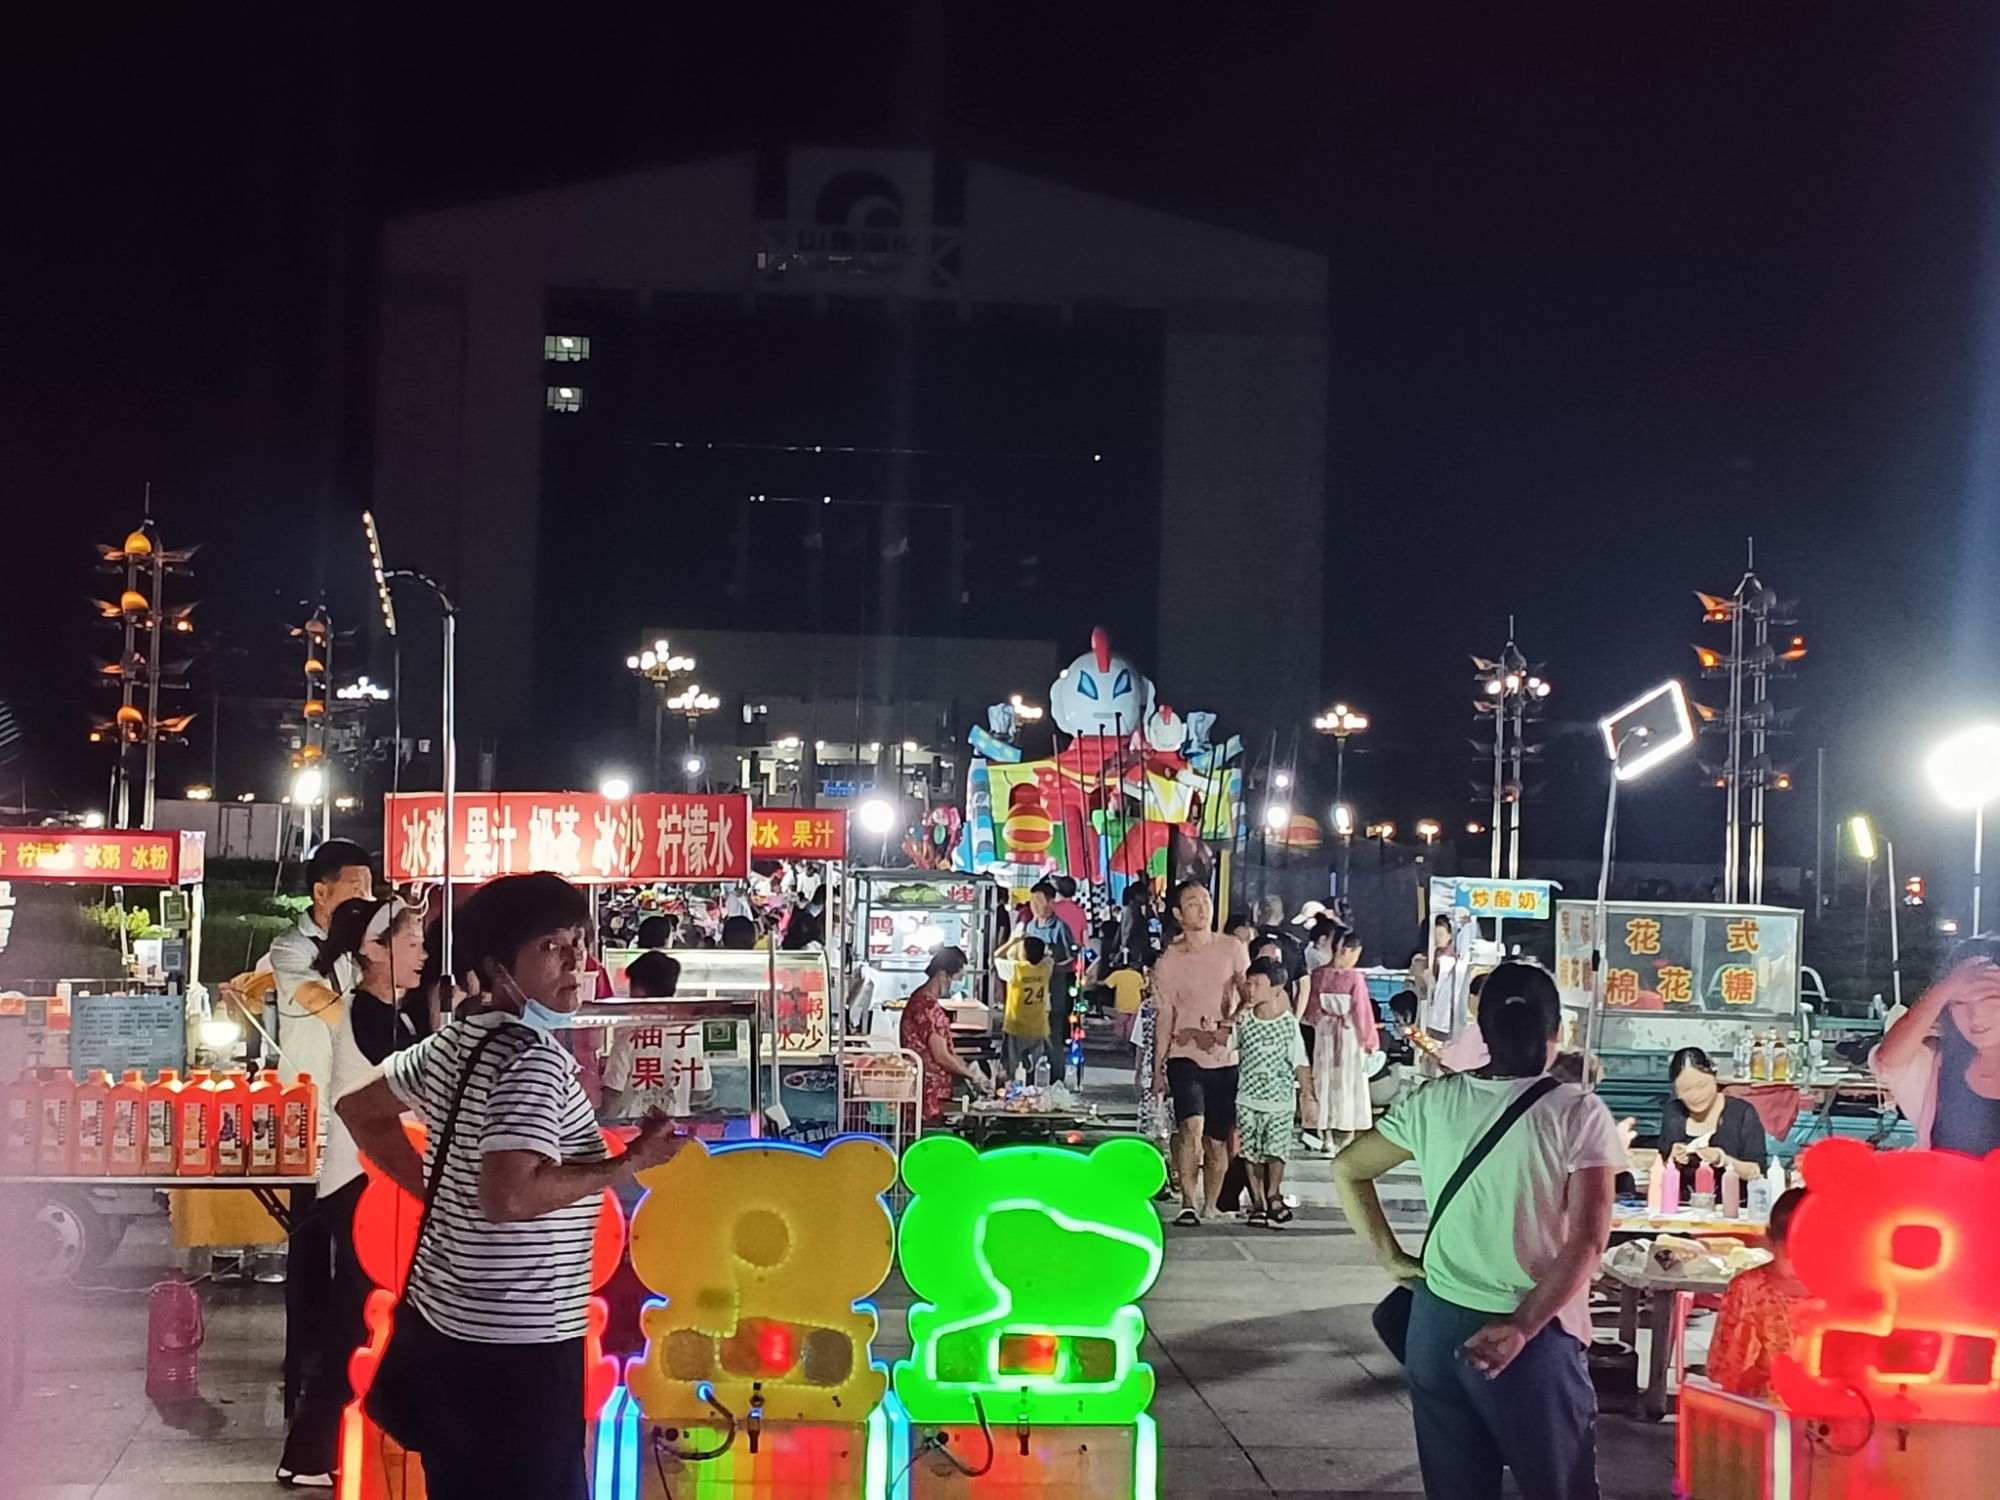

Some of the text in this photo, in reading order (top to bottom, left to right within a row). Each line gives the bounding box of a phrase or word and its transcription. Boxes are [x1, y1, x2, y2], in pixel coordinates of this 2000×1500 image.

[464, 805, 517, 878] 果汁
[529, 805, 581, 876] 奶茶
[592, 805, 644, 876] 冰沙
[657, 803, 734, 876] 柠檬水
[792, 819, 834, 849] 果汁
[84, 844, 121, 870] 冰粥
[131, 845, 168, 870] 冰粉
[1471, 889, 1537, 910] 炒酸奶
[1626, 918, 1760, 954] 花式
[1024, 986, 1044, 1005] 24
[1606, 966, 1756, 1004] 棉花糖
[630, 1023, 700, 1049] 柚子
[632, 1057, 704, 1089] 果汁
